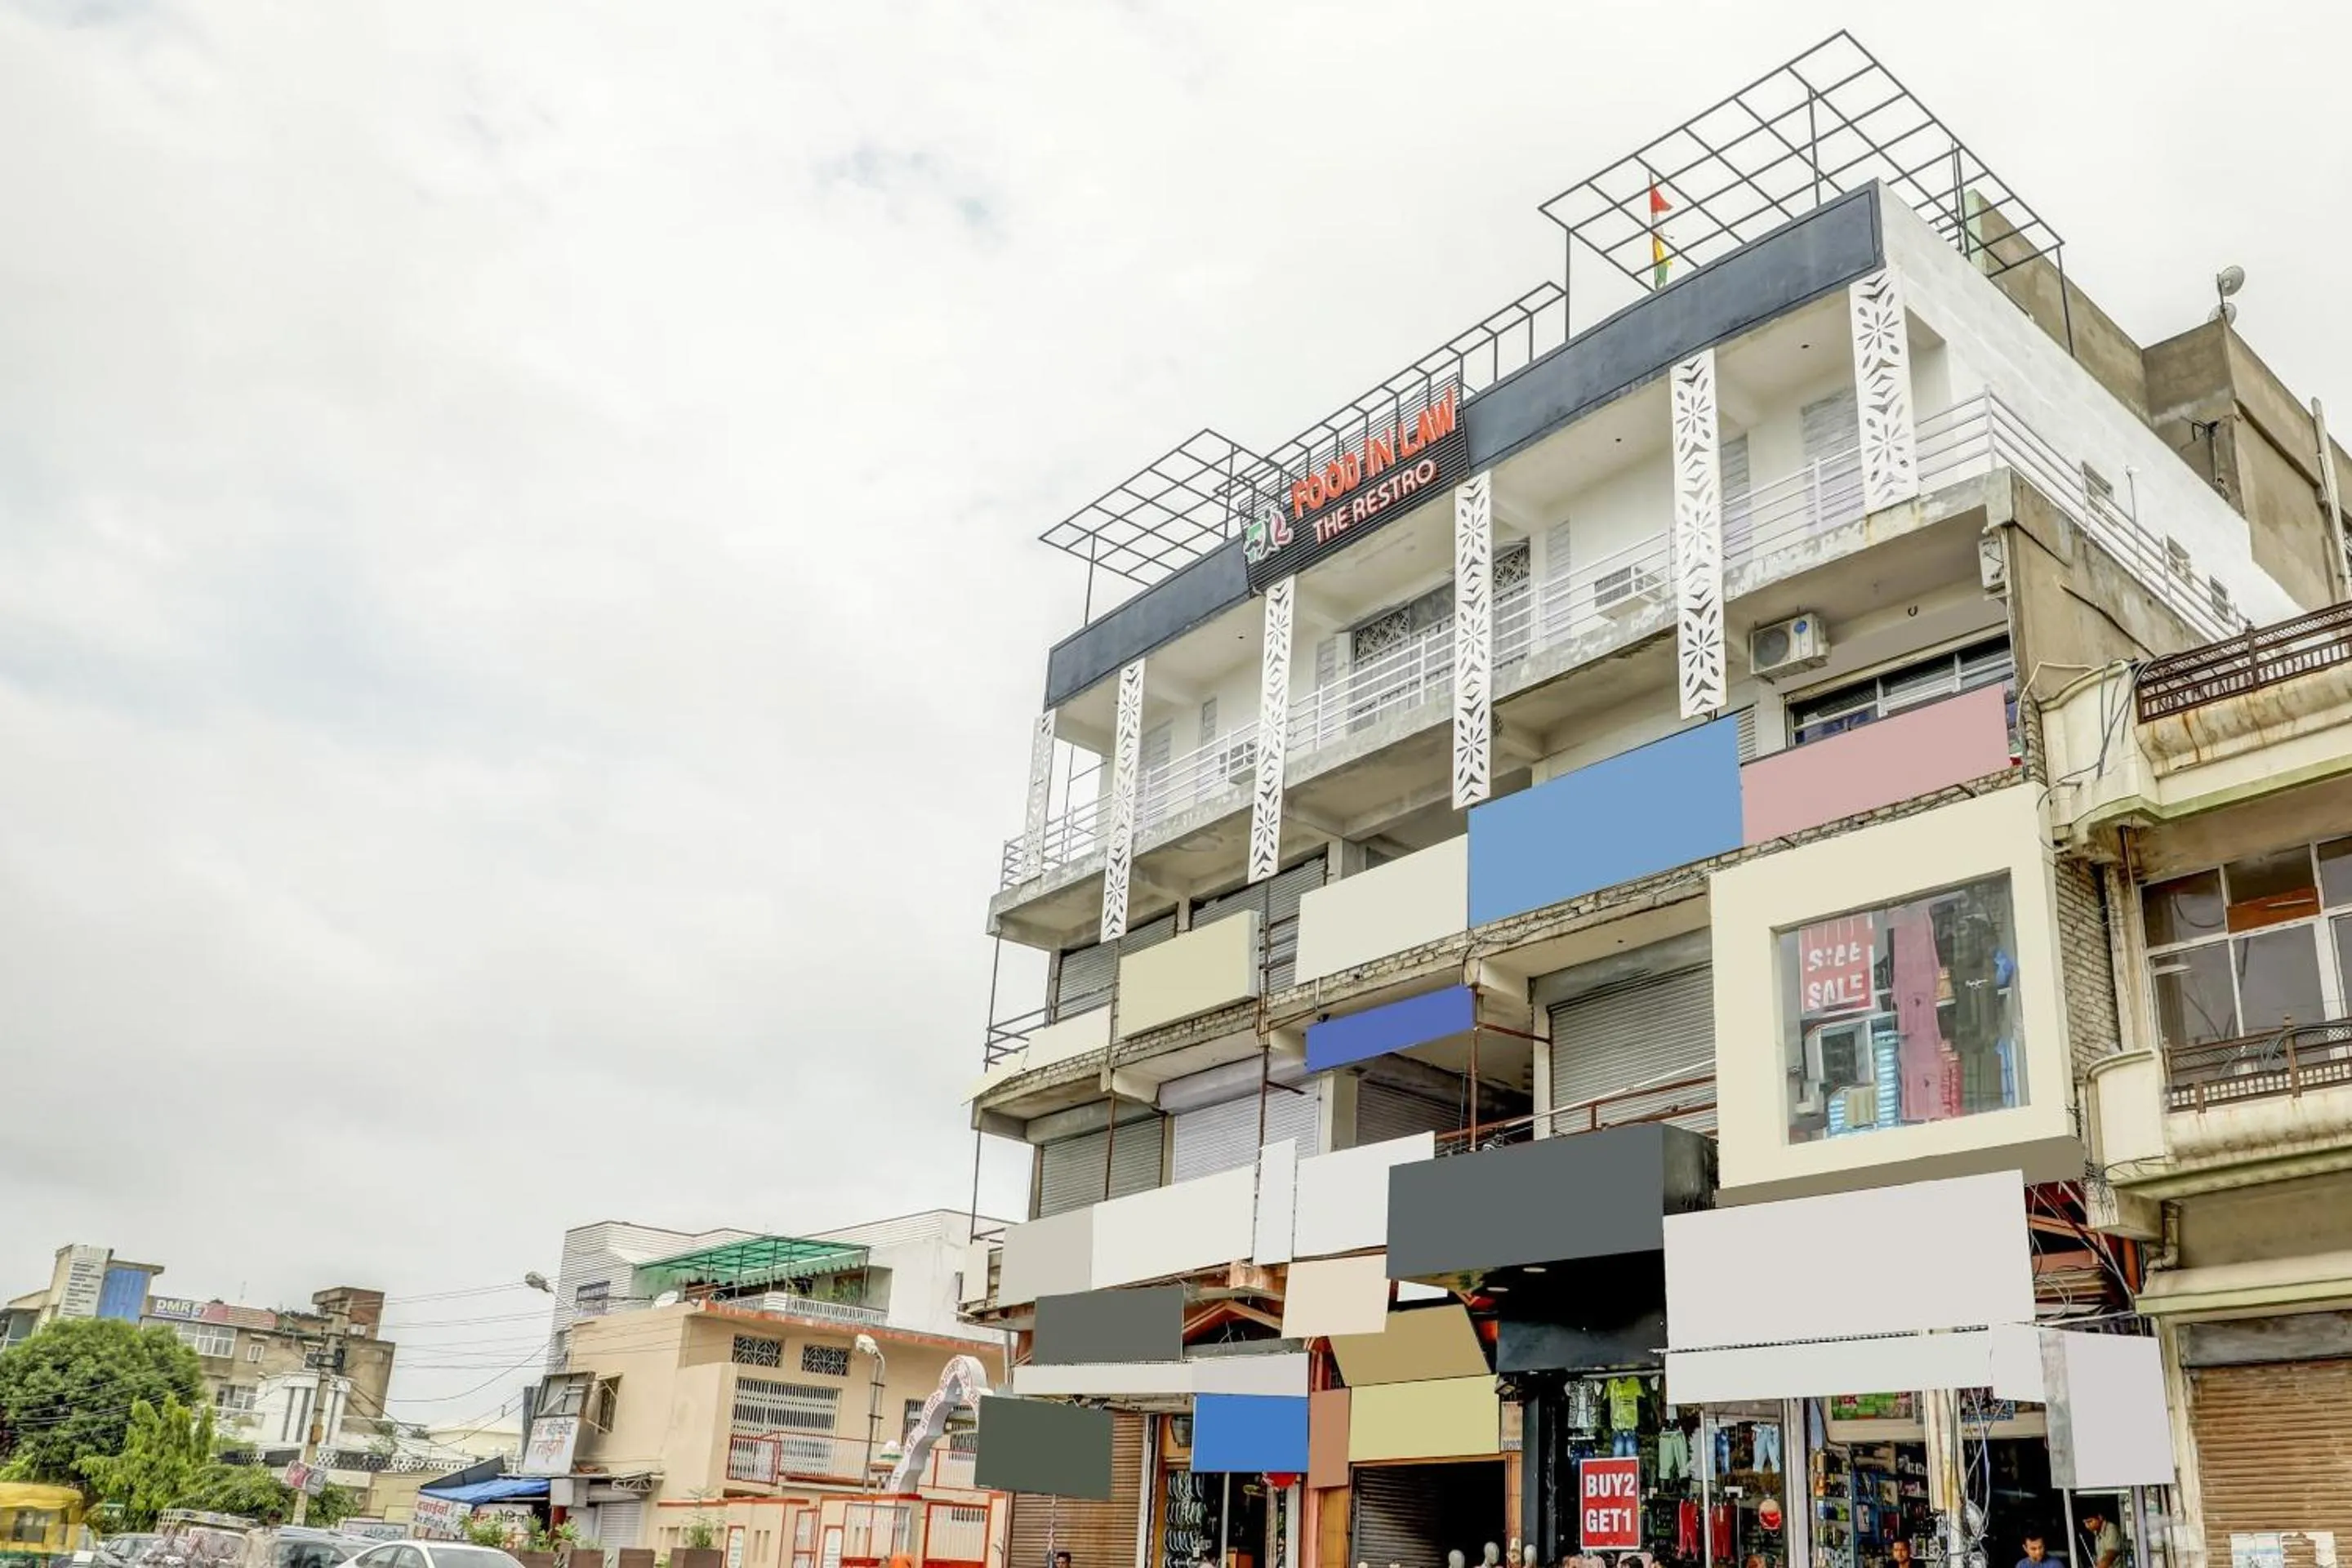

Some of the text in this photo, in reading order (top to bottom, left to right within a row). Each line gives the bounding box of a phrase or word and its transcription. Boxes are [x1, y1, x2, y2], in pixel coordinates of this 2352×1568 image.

[1290, 385, 1457, 519] FOOD IN LAW
[1312, 458, 1438, 546] THE RESTRO
[1806, 973, 1866, 1010] SALE
[1585, 1472, 1636, 1498] BUY2
[1586, 1508, 1633, 1533] GET1
